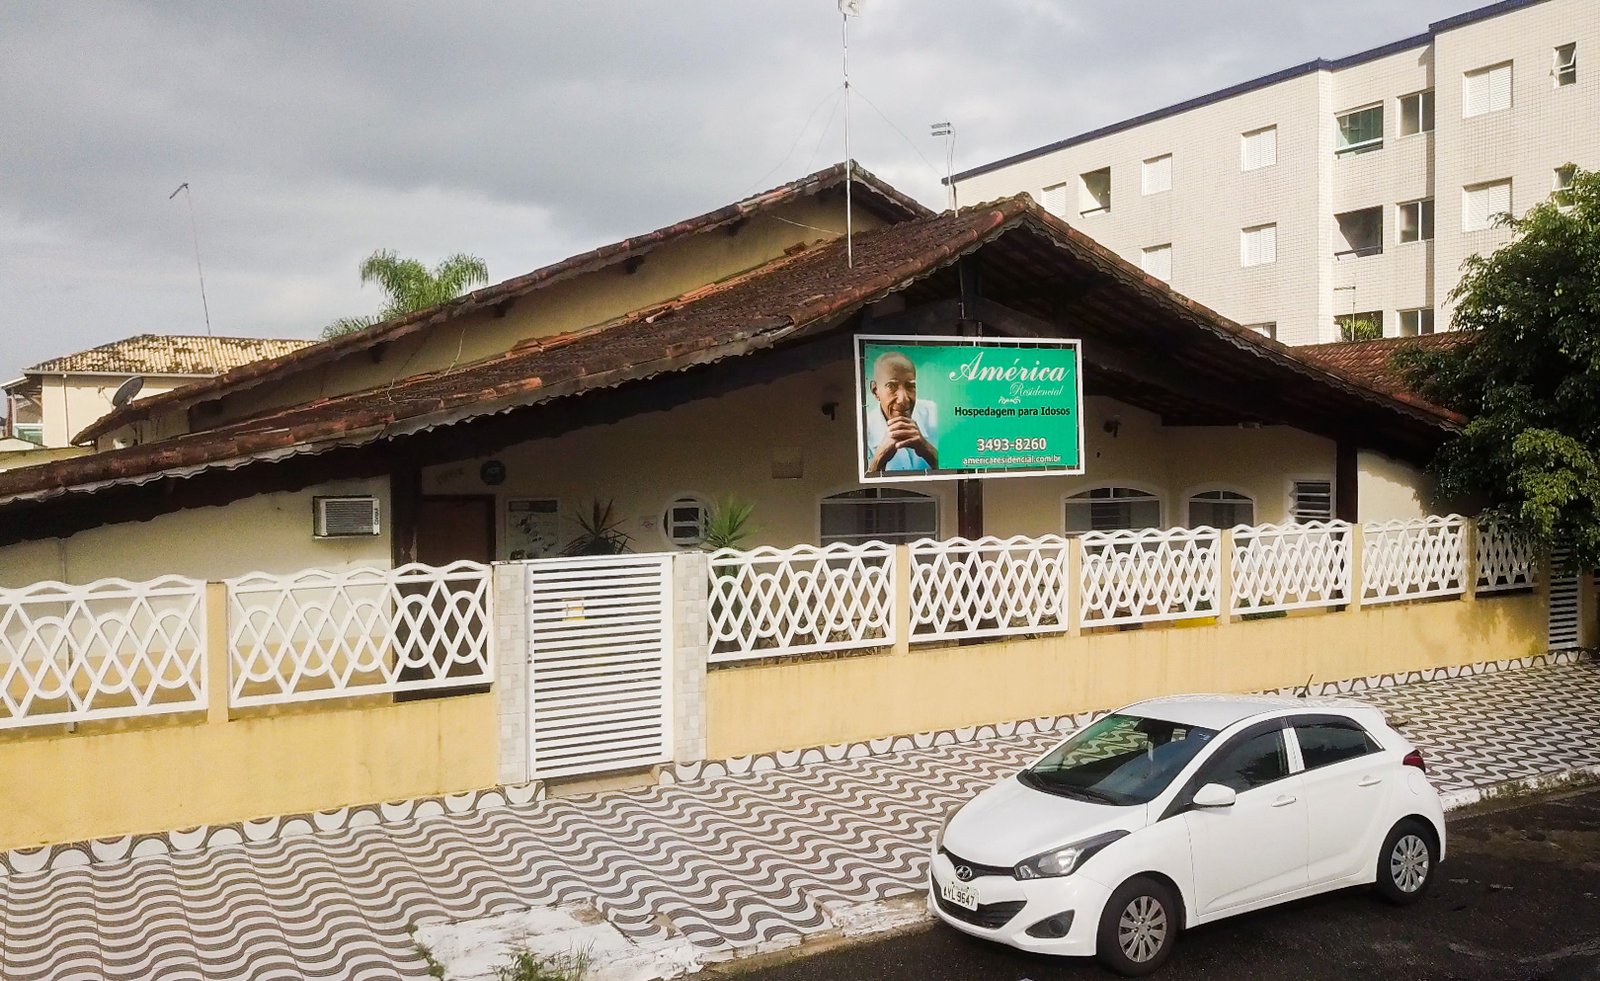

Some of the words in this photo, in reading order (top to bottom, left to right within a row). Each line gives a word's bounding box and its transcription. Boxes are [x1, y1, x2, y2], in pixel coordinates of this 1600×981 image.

[948, 351, 1070, 382] América
[1009, 381, 1064, 397] Residencial
[954, 406, 1015, 418] Hospedagem
[1018, 408, 1038, 418] para
[1040, 406, 1071, 416] Idosos
[976, 437, 1047, 452] 3493-8260
[962, 454, 1061, 466] americaresidencial.com.br
